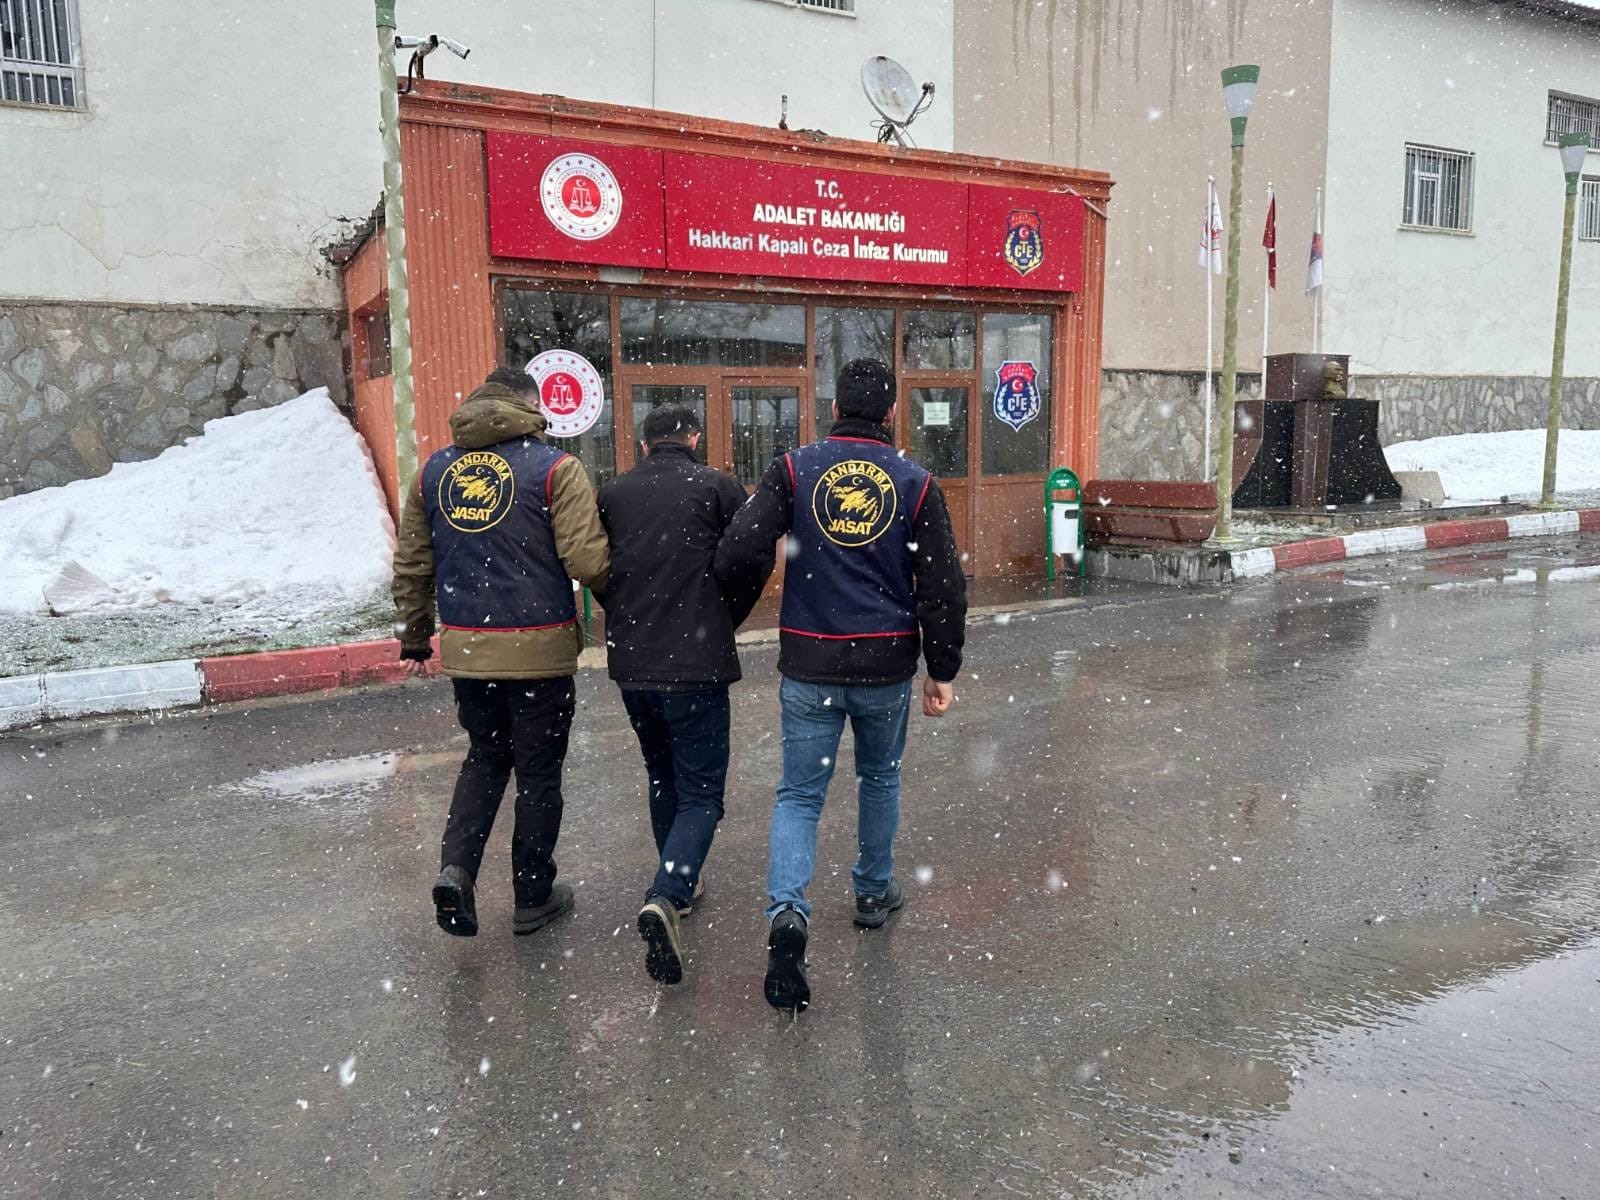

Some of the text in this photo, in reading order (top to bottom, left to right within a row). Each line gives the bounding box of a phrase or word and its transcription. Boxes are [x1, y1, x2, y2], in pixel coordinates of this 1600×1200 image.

[815, 179, 843, 199] T.C.
[753, 203, 905, 233] ADALET BAKANLIĞI
[688, 228, 948, 264] Hakkari Kapalı Ceza İnfaz Kurumu
[1014, 240, 1033, 258] CTE
[1007, 393, 1028, 411] CTE
[450, 454, 511, 482] JANDARMA
[824, 463, 892, 493] JANDARMA
[451, 506, 493, 521] JASAT
[828, 518, 874, 535] JASAT
